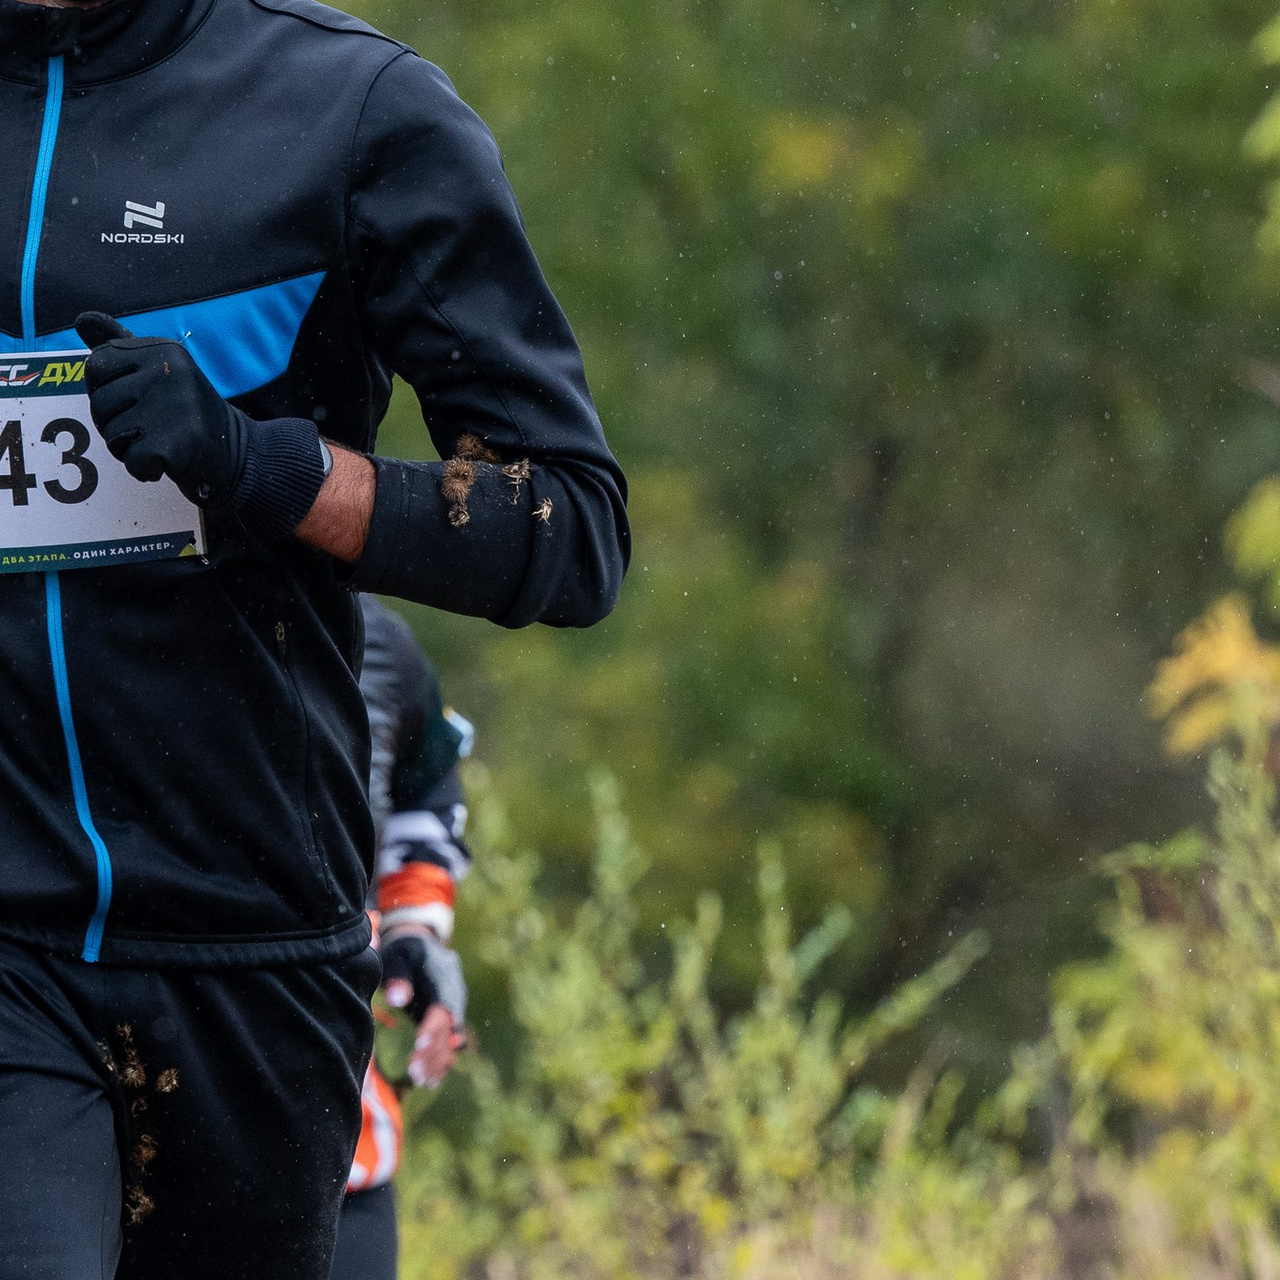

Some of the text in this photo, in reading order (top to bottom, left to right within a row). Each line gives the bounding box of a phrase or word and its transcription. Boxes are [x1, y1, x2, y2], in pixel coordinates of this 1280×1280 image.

[101, 232, 185, 244] NORDSKI
[2, 541, 175, 565] ДВА ЭТАПА. ОДИН ХАРАКТЕР.
